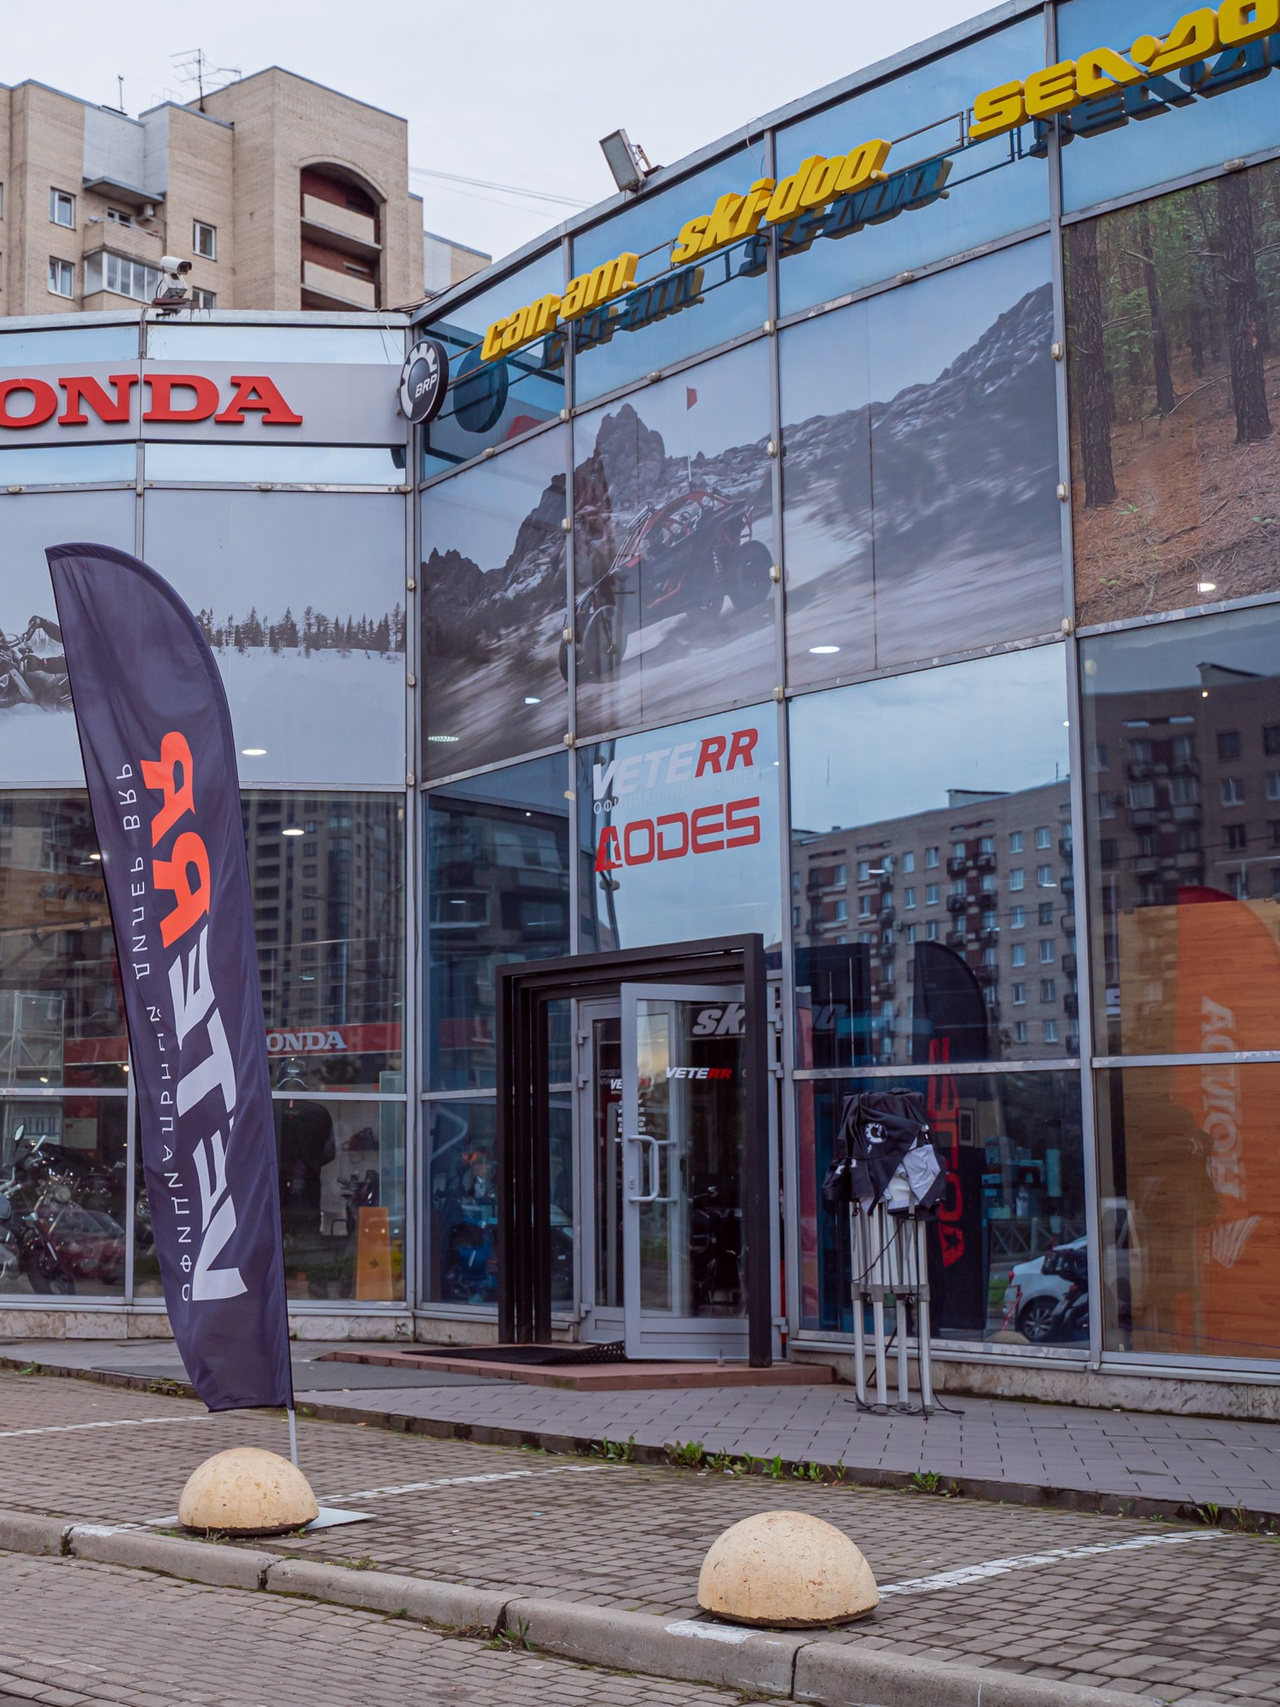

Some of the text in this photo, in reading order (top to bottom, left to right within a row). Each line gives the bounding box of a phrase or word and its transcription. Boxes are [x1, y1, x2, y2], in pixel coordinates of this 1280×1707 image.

[414, 373, 438, 399] BRP
[592, 727, 759, 800] VETERR
[594, 796, 761, 872] AODES
[266, 1031, 347, 1052] ONDA
[665, 1066, 733, 1080] VETERR
